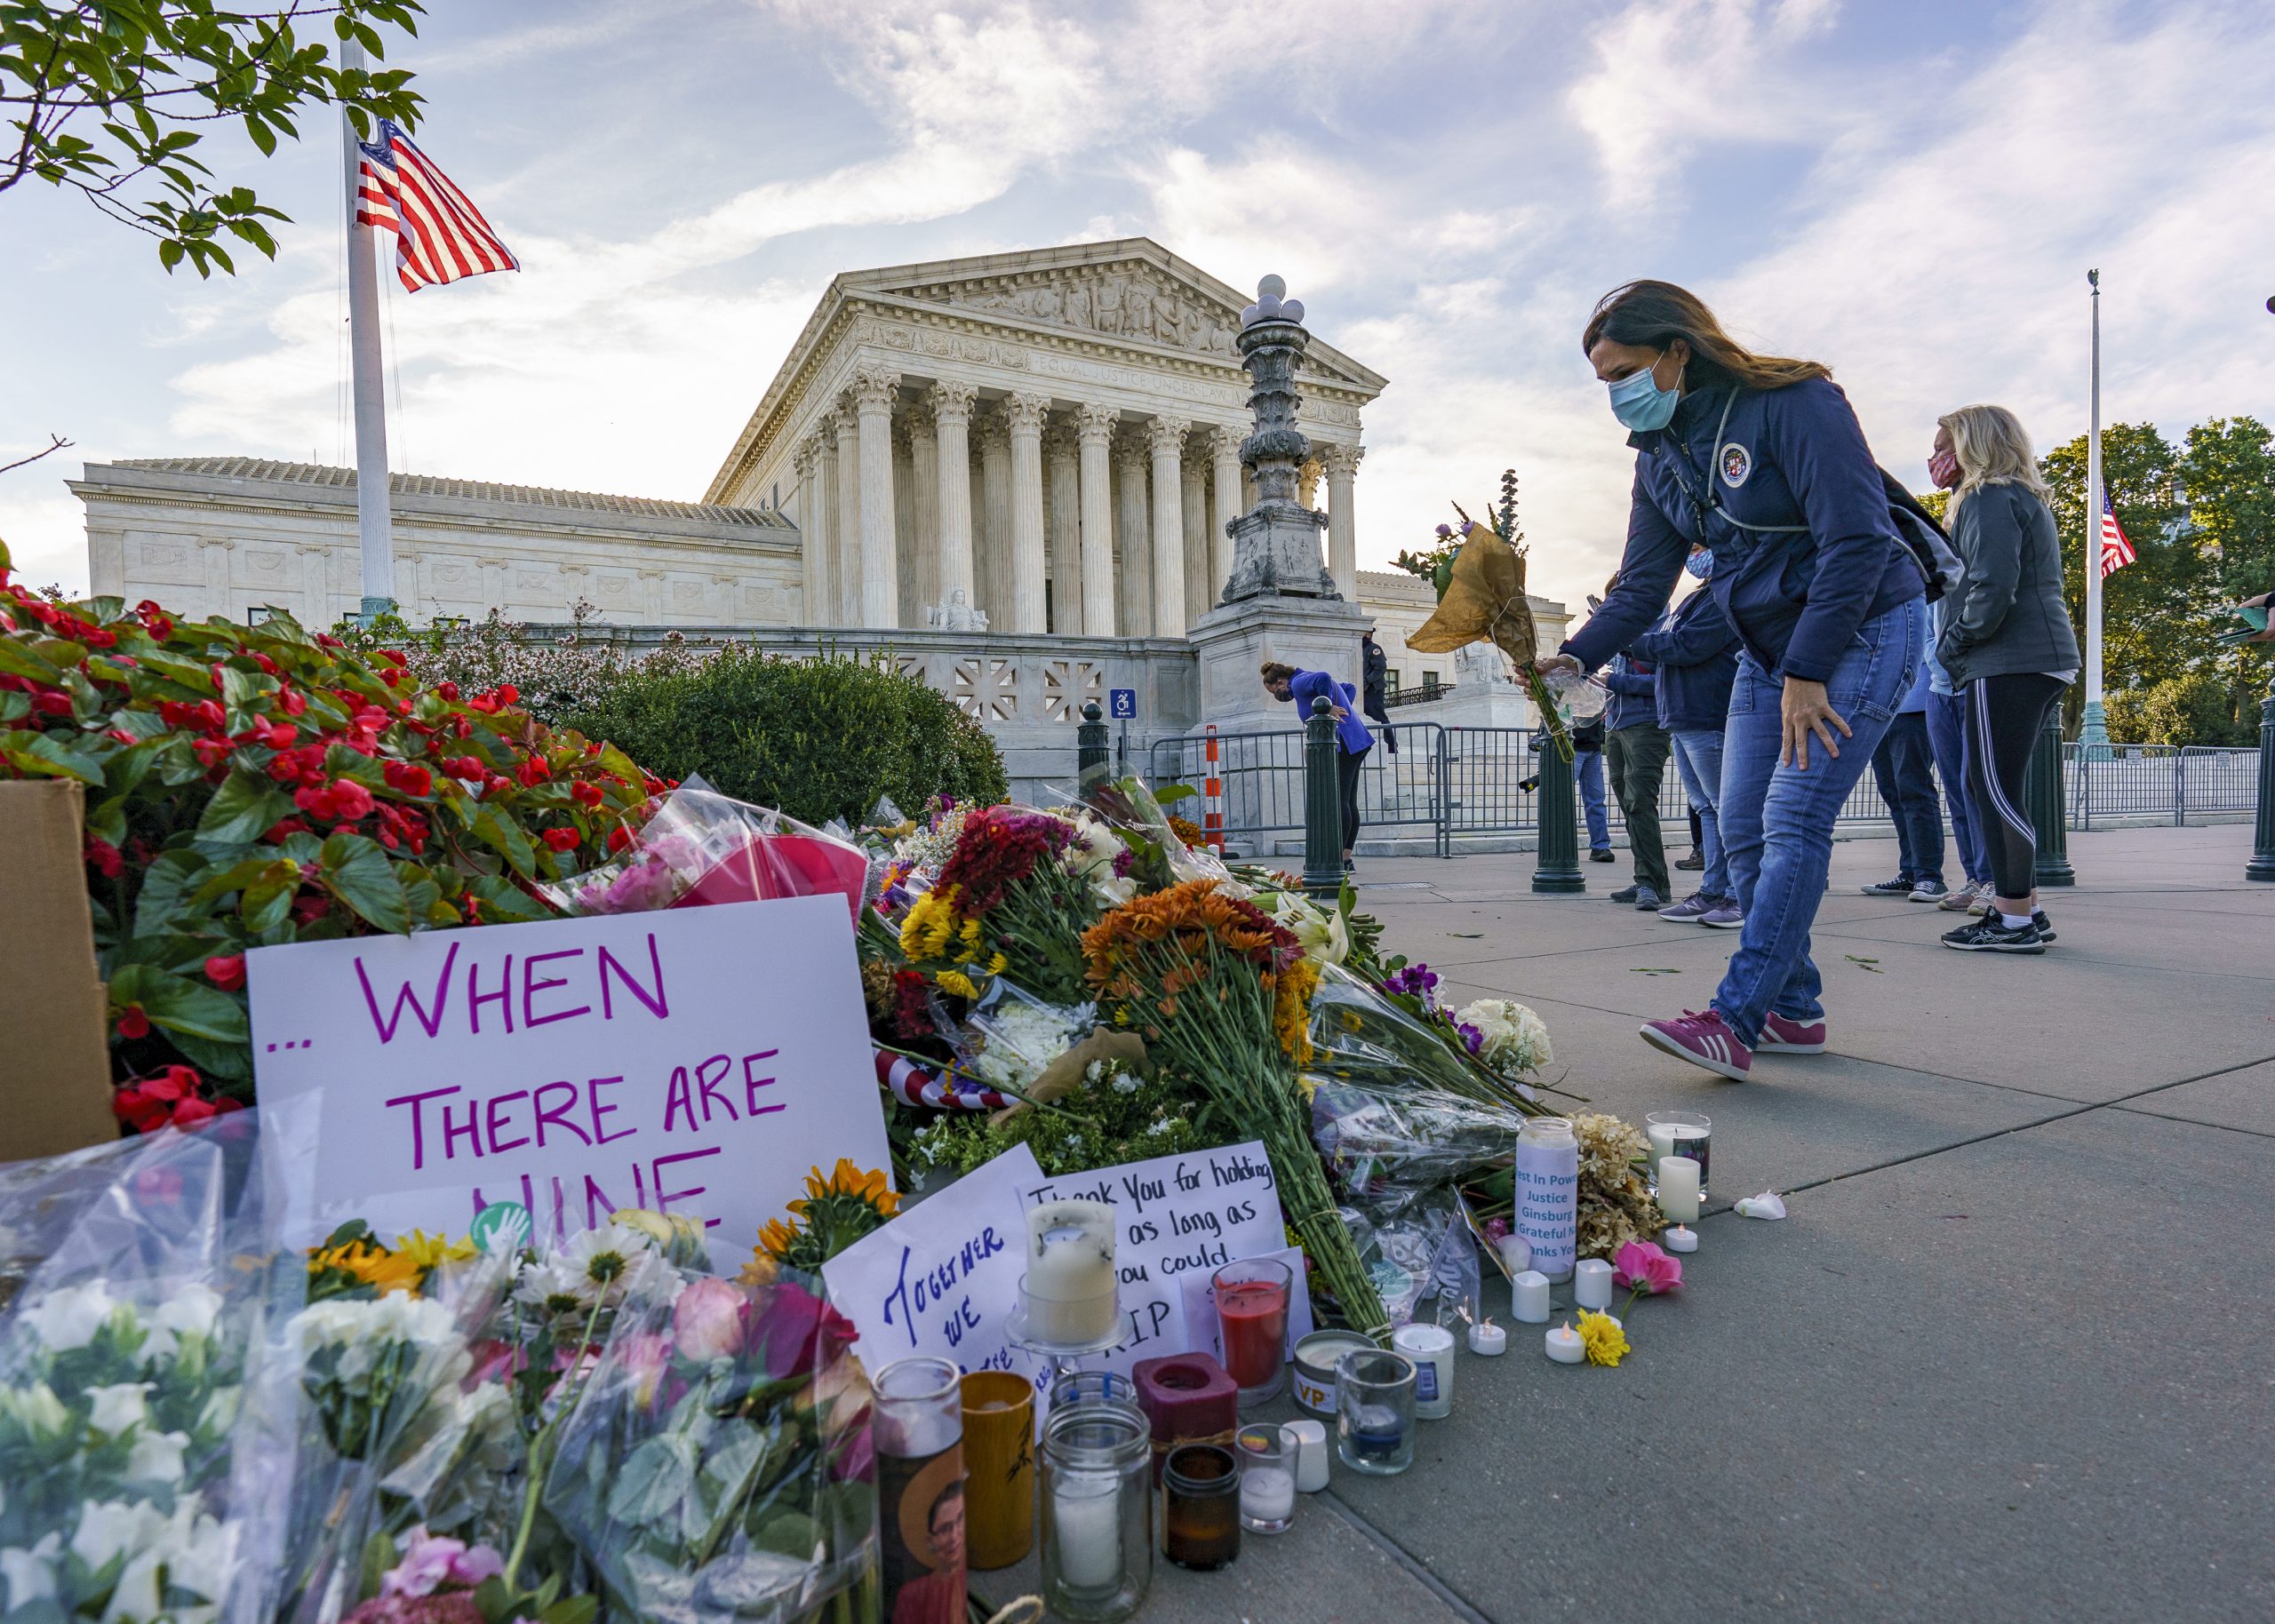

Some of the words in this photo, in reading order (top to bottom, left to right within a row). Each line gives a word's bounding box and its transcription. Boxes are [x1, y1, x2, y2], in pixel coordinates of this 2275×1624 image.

[1040, 357, 1090, 377] EQUAL
[1092, 365, 1146, 387] JUSTICE
[1153, 375, 1196, 394] UNDER
[1202, 385, 1226, 400] LAW
[354, 933, 668, 1044] WHEN
[386, 1076, 637, 1169] THERE
[664, 1048, 786, 1132] ARE
[1027, 1182, 1118, 1205] Tnk
[1122, 1173, 1166, 1214] You
[1173, 1162, 1201, 1191] for
[1209, 1155, 1273, 1190] holding
[1516, 1169, 1530, 1183] est
[1534, 1173, 1545, 1185] In
[1550, 1174, 1577, 1186] Powe
[1527, 1190, 1568, 1204] Justice
[1129, 1220, 1159, 1245] as
[1169, 1209, 1221, 1238] long
[1227, 1200, 1257, 1224] as
[1519, 1223, 1566, 1239] Grateful
[1521, 1206, 1572, 1222] Ginsburg
[1115, 1264, 1149, 1285] ou
[1161, 1243, 1235, 1274] could.
[1530, 1246, 1557, 1257] anks
[884, 1227, 1004, 1348] TOGETHER
[944, 1294, 981, 1348] WE
[1105, 1301, 1169, 1358] IP
